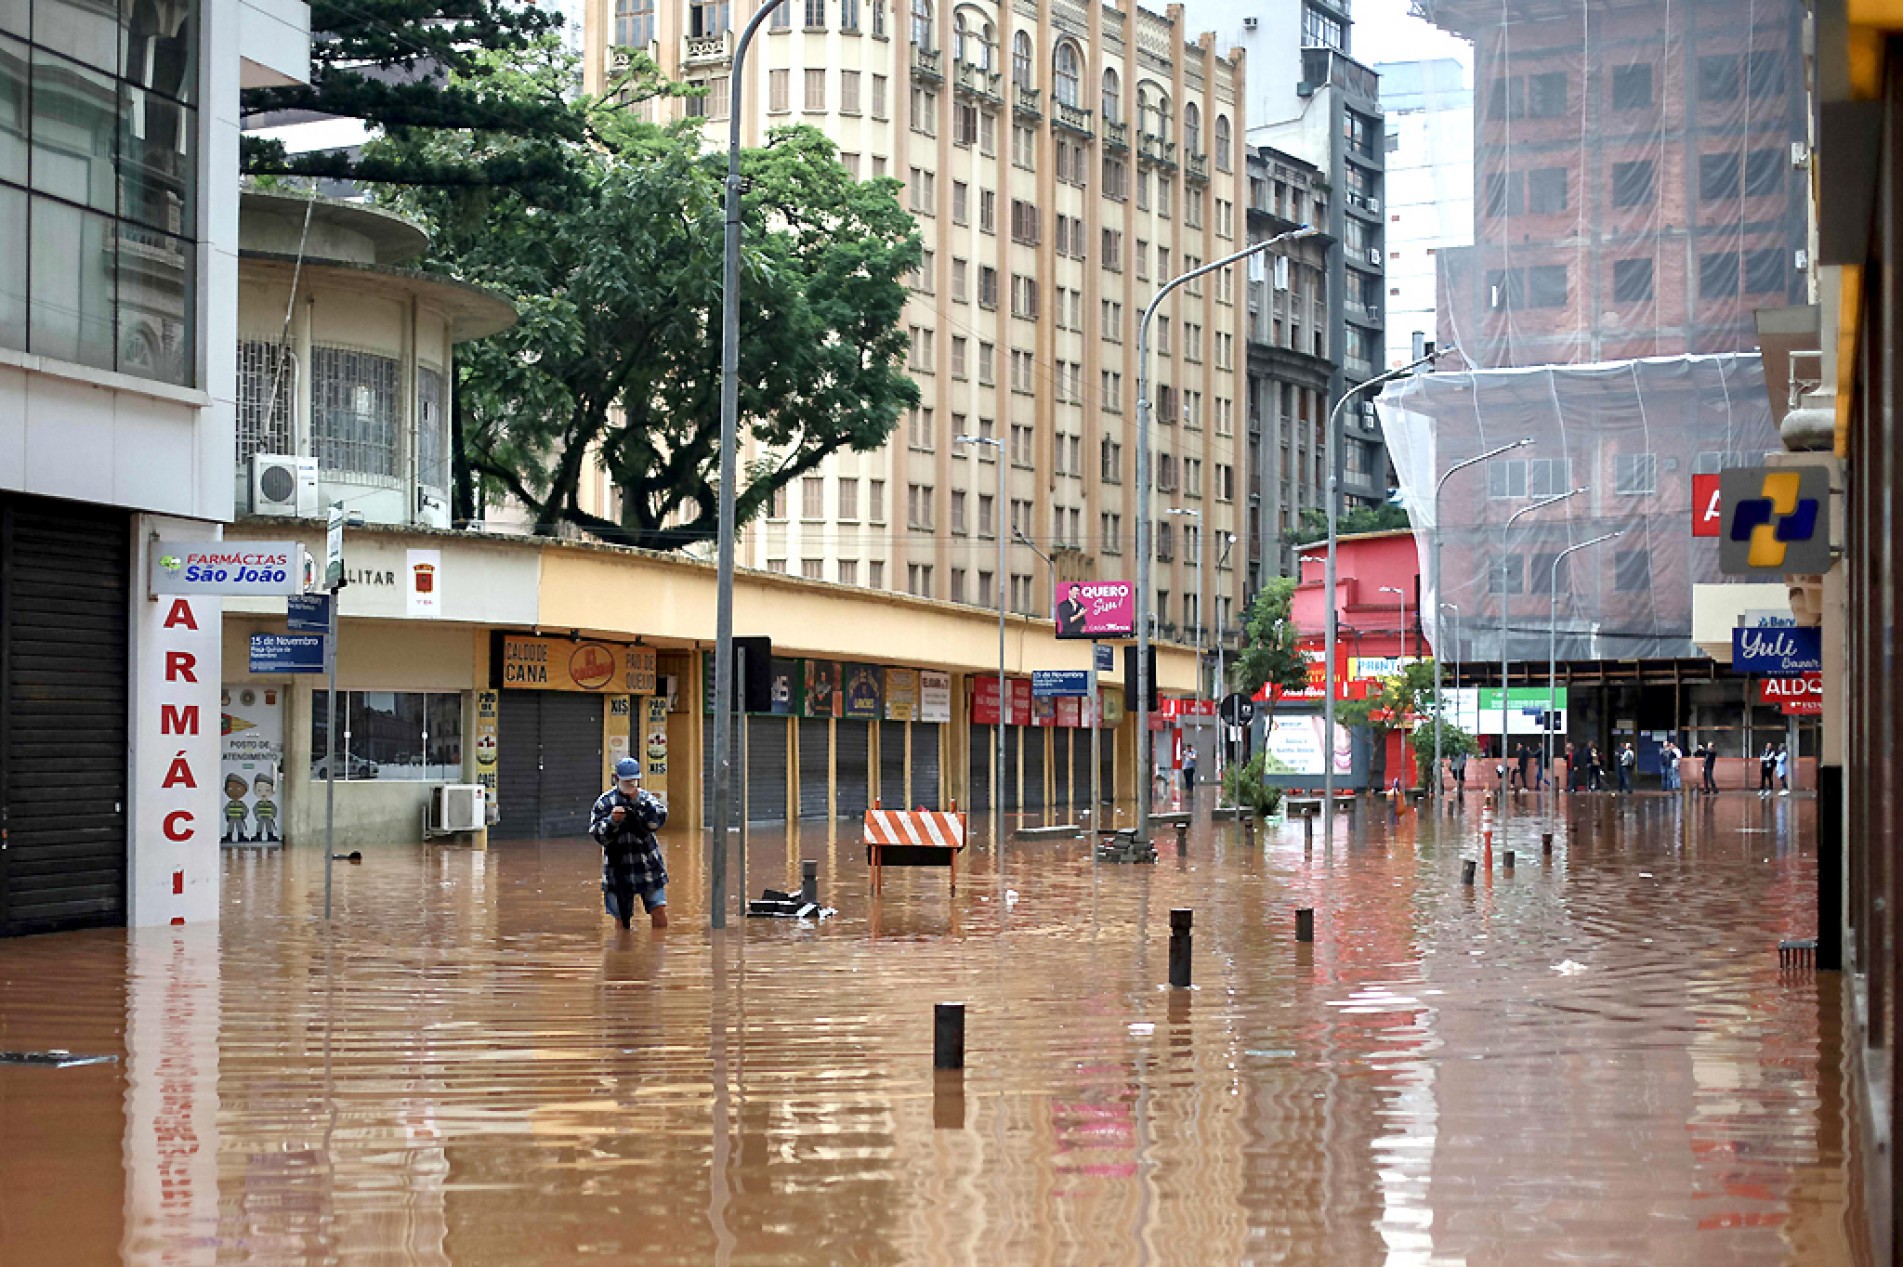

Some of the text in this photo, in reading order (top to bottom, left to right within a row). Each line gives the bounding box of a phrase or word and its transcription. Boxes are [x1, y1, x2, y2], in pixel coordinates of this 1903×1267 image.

[187, 552, 287, 565] FARMÁCIAS
[185, 565, 287, 583] São João
[1081, 585, 1129, 598] QUERO
[251, 636, 319, 645] 15 de Novembro
[1740, 629, 1798, 659] Yuli
[506, 642, 548, 661] CALDO DE
[644, 655, 655, 671] DE
[506, 663, 547, 682] CANA
[626, 672, 655, 689] QUEIJO
[611, 698, 627, 714] XIS
[230, 740, 270, 749] POSTO DE
[160, 598, 200, 915] ARMÁCI
[222, 752, 278, 761] ATENDIMENTO
